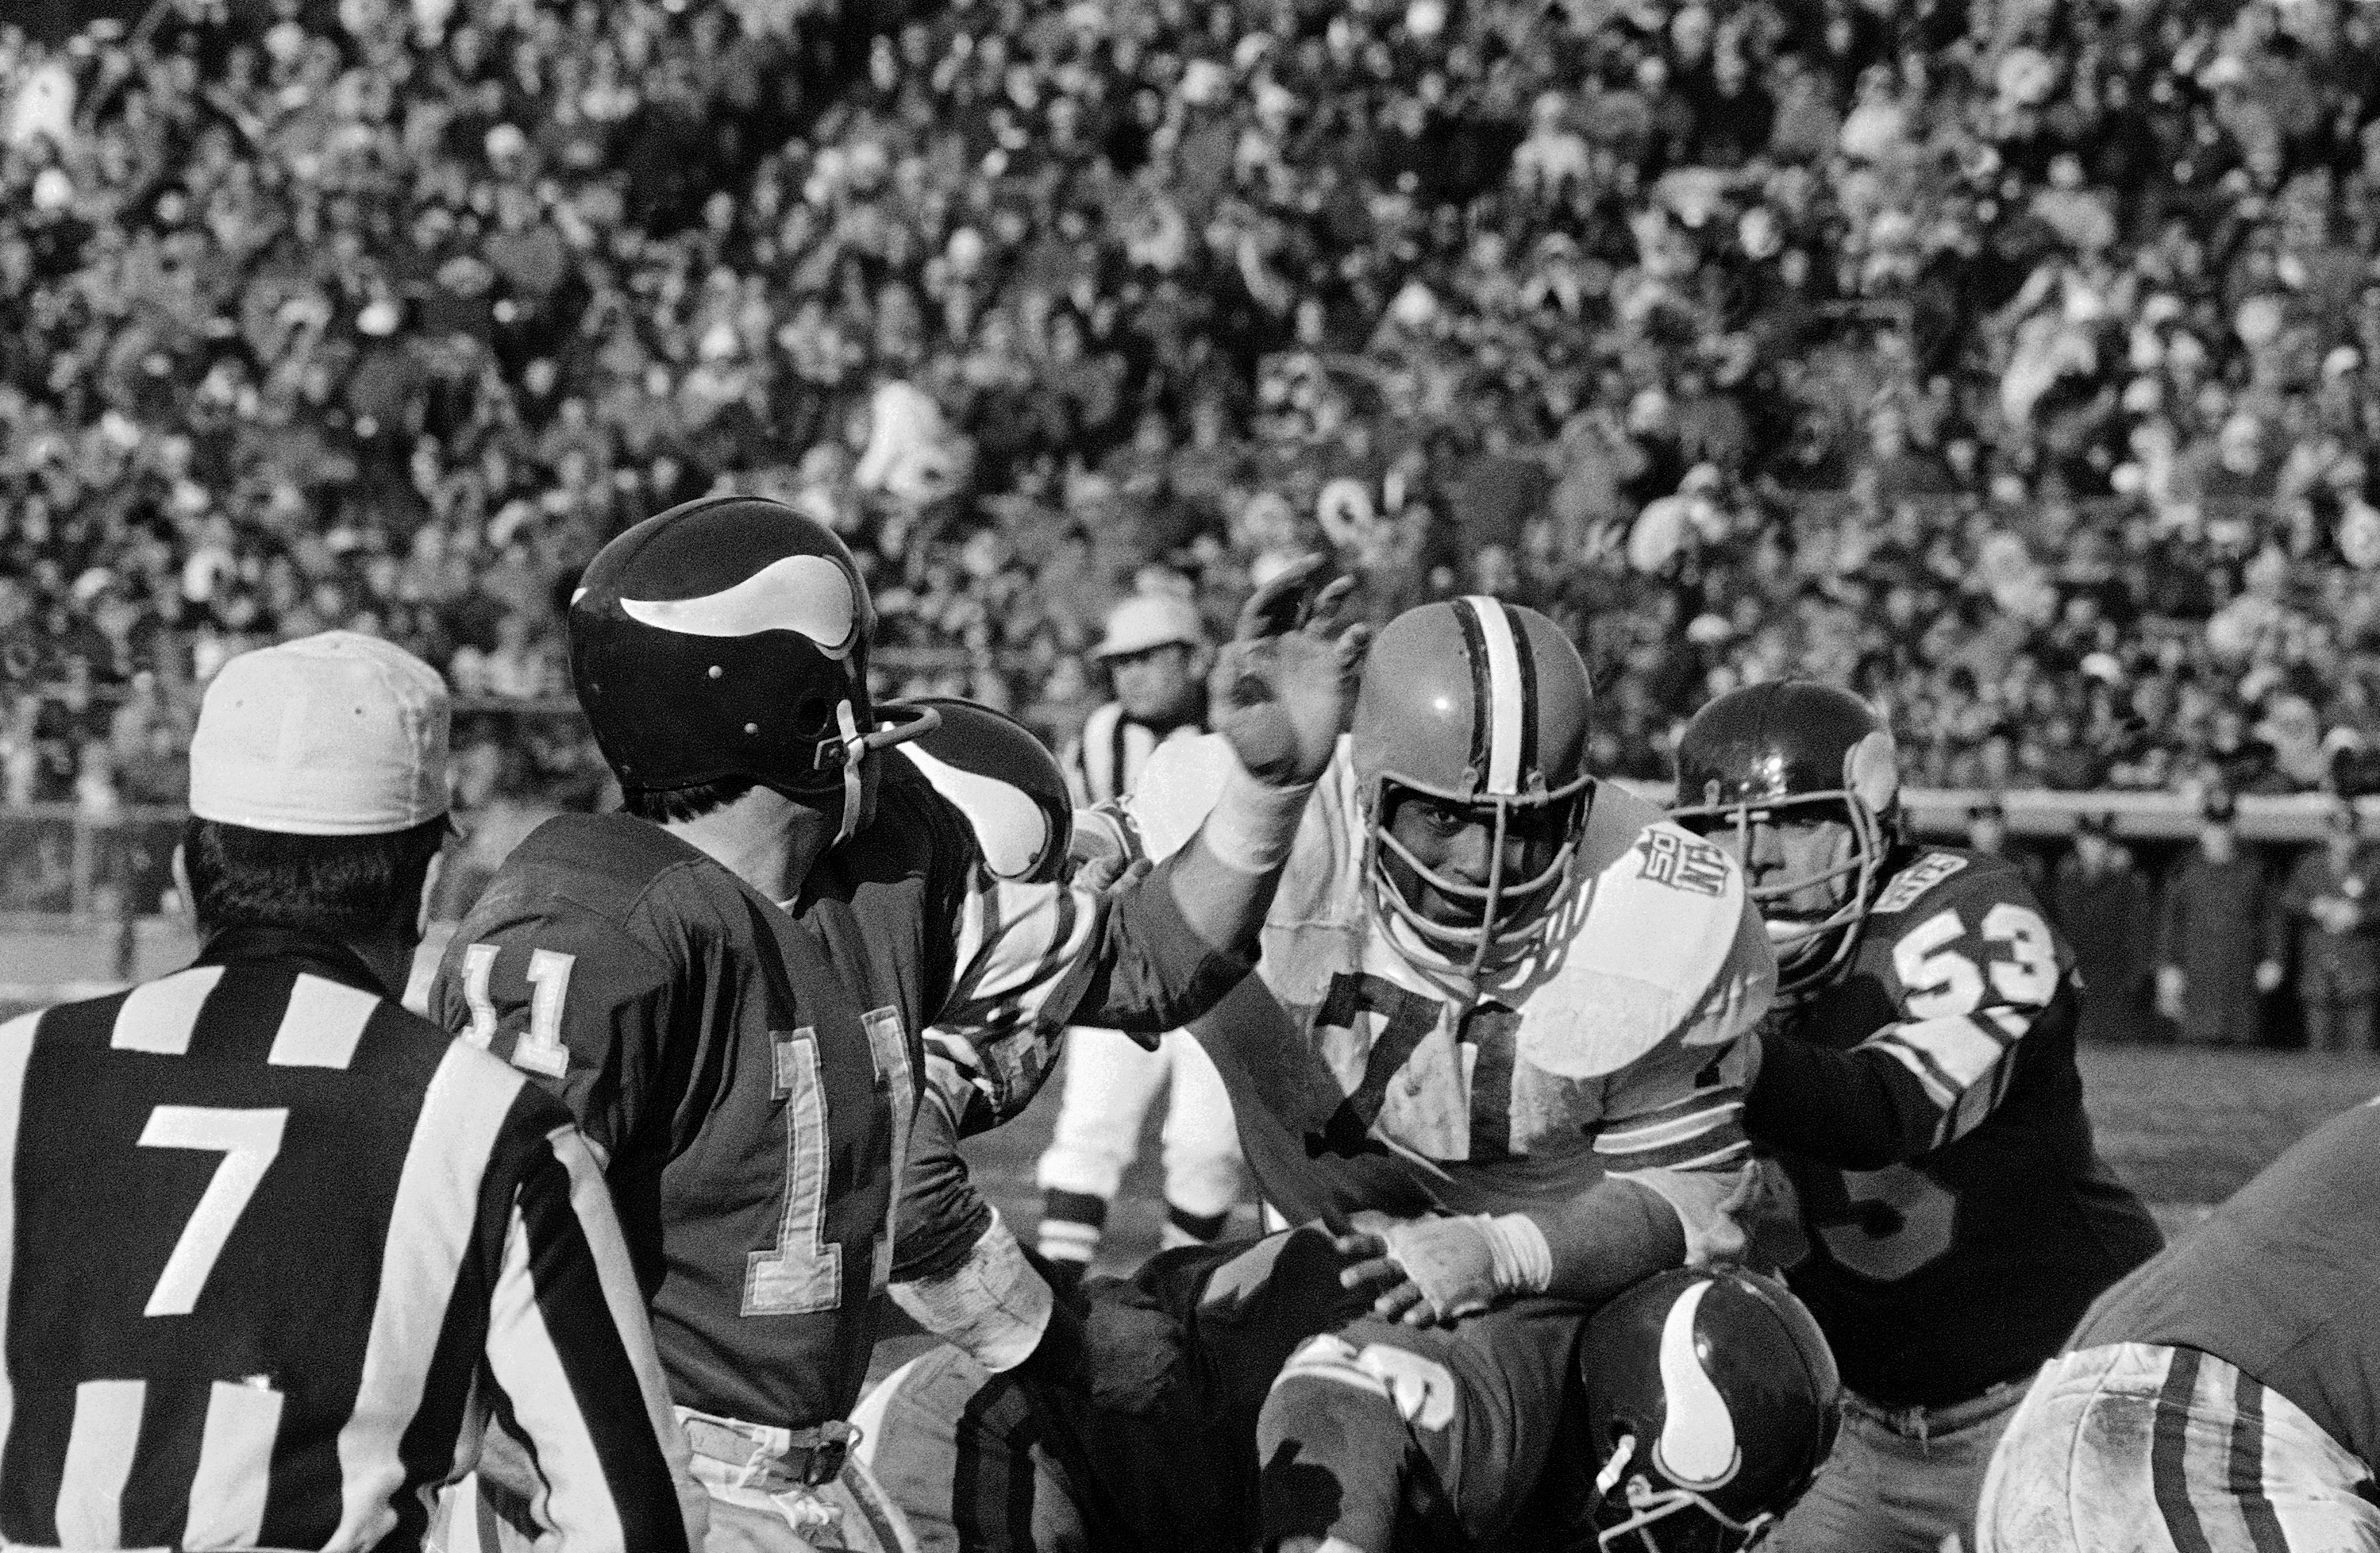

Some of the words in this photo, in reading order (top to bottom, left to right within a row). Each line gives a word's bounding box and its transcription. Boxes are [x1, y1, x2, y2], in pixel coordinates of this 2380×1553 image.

[1646, 832, 1677, 881] 50
[462, 943, 576, 1079] 11
[1893, 902, 2058, 1020] 53
[137, 1105, 290, 1316] 7
[740, 1005, 915, 1317] 11
